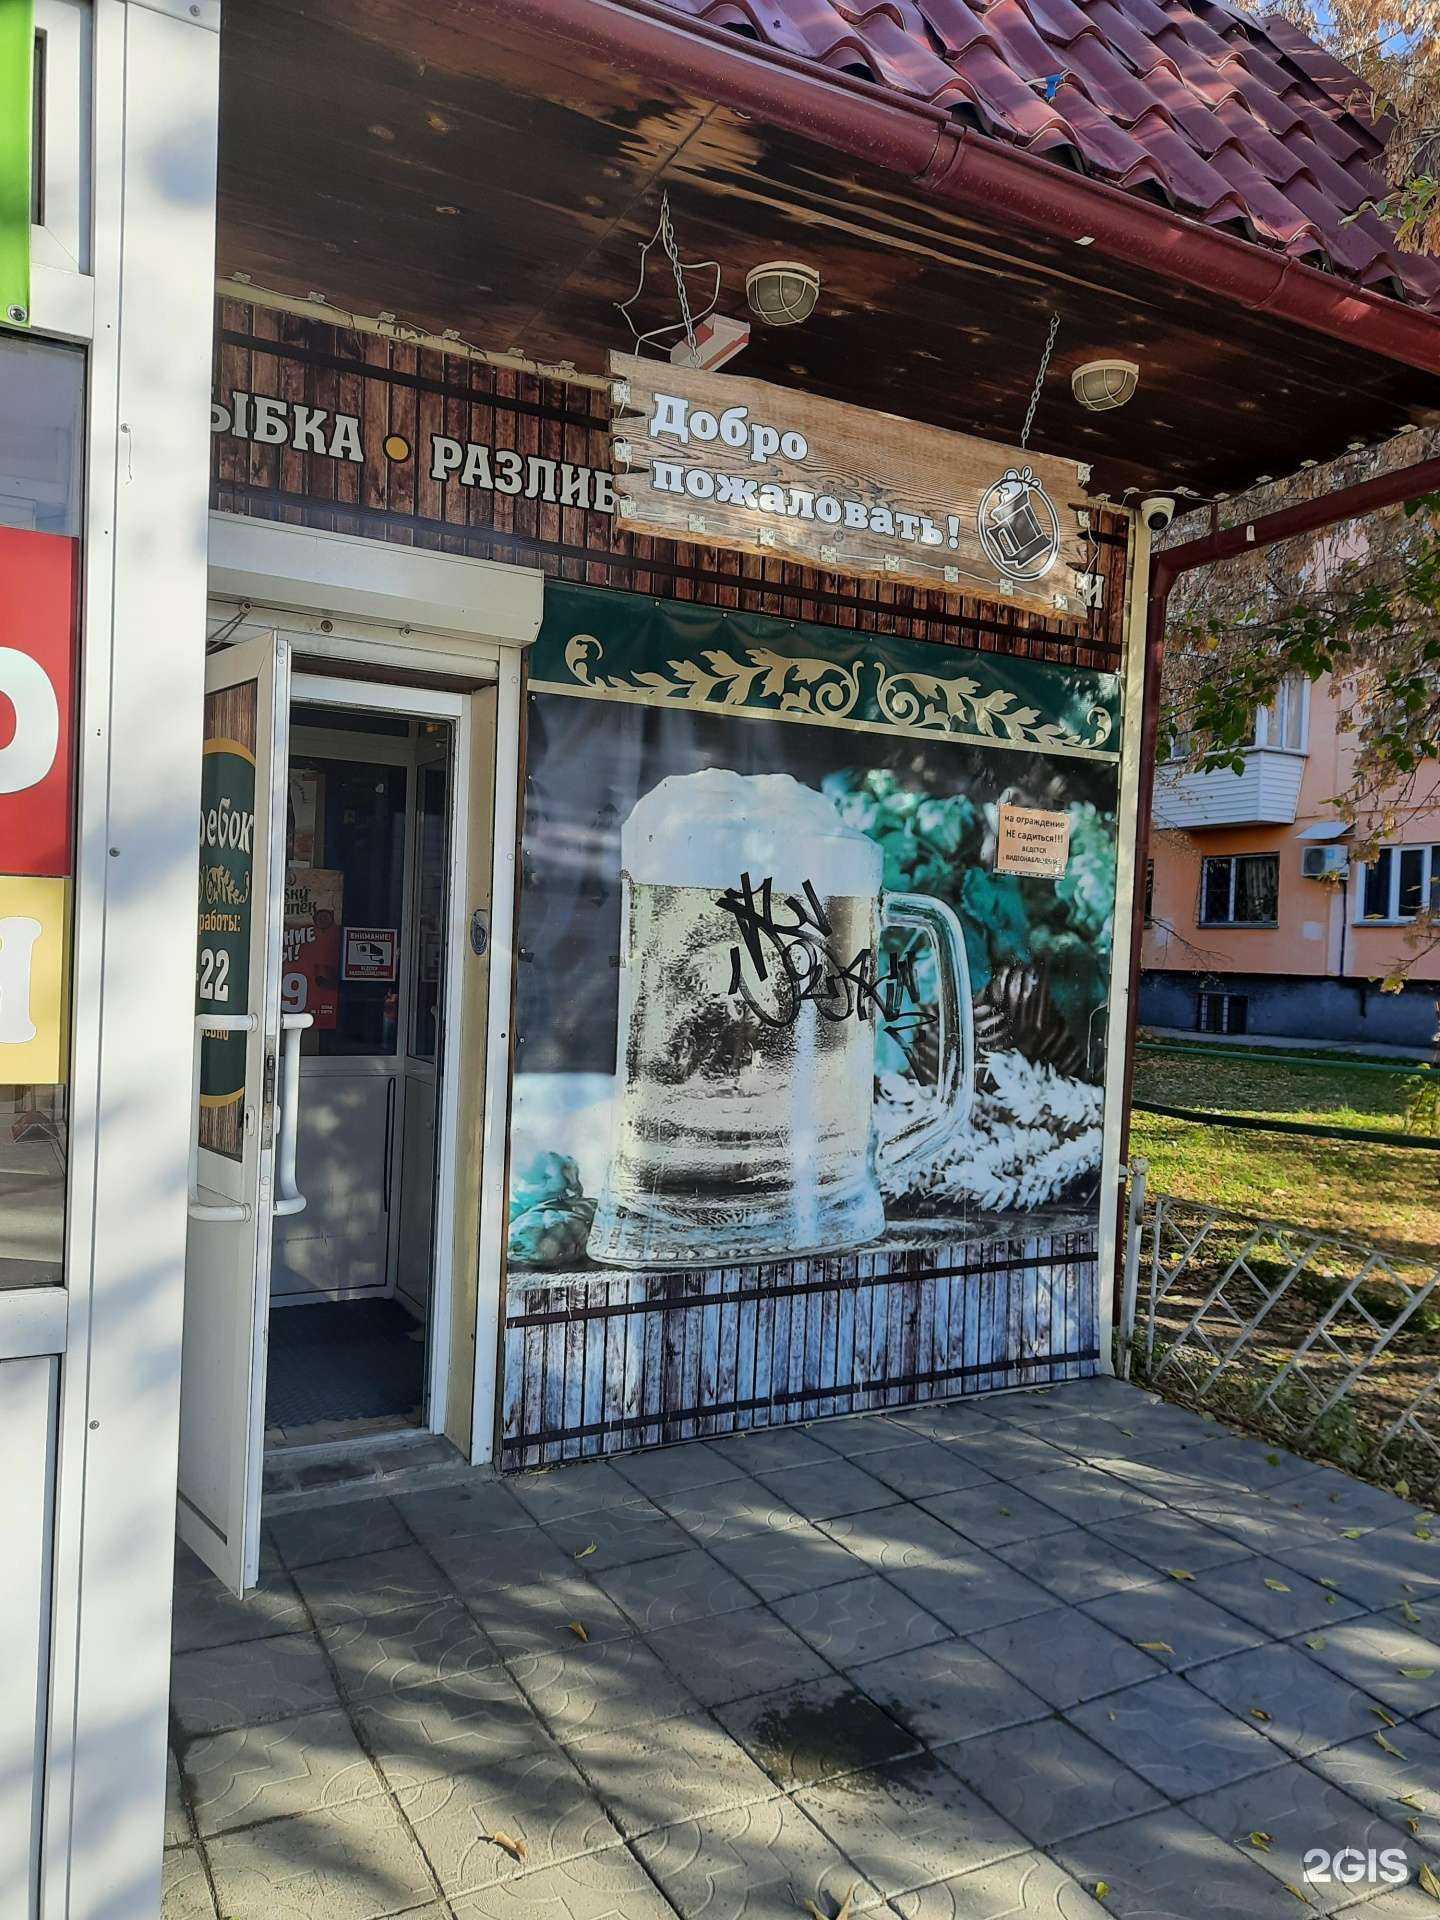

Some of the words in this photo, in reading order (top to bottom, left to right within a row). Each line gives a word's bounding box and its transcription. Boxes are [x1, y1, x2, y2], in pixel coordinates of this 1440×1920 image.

[650, 393, 808, 461] Добро
[651, 460, 960, 550] пожаловать!
[1006, 829, 1016, 839] НЕ
[1018, 832, 1063, 843] садиться!!!
[1015, 816, 1065, 828] ограждение
[199, 909, 241, 934] работы:
[200, 948, 229, 1002] 22
